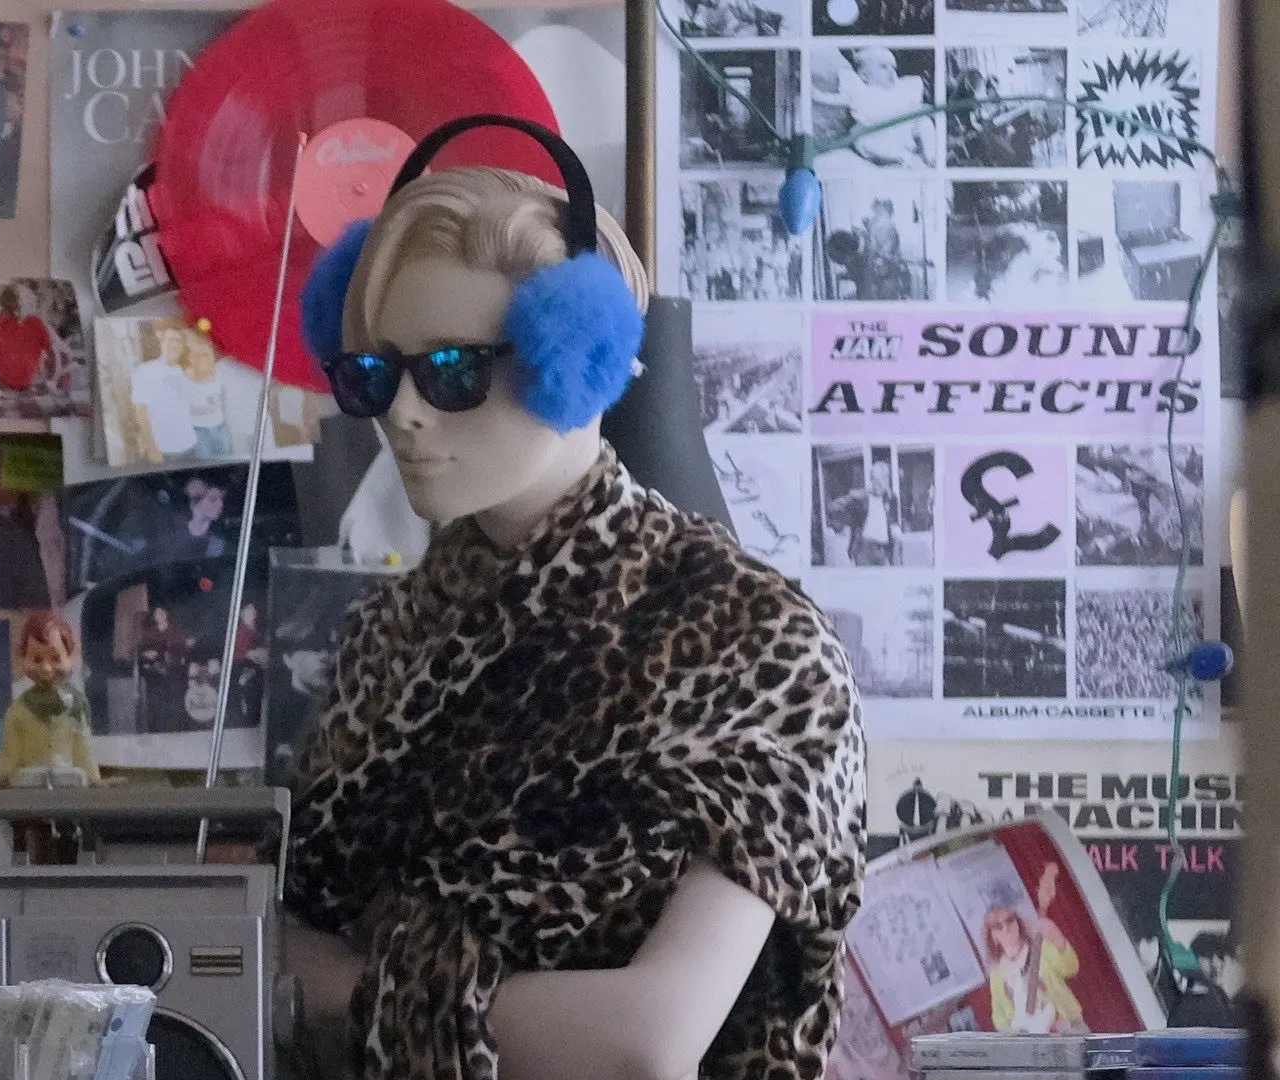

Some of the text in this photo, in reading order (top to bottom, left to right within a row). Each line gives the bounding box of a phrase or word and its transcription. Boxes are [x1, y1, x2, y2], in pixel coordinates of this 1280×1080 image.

[849, 319, 888, 333] THE
[917, 321, 1202, 359] SOUND
[828, 334, 903, 361] JAM
[808, 379, 1203, 415] AFFECTS
[978, 771, 1088, 799] THE
[1154, 843, 1226, 872] TALK
